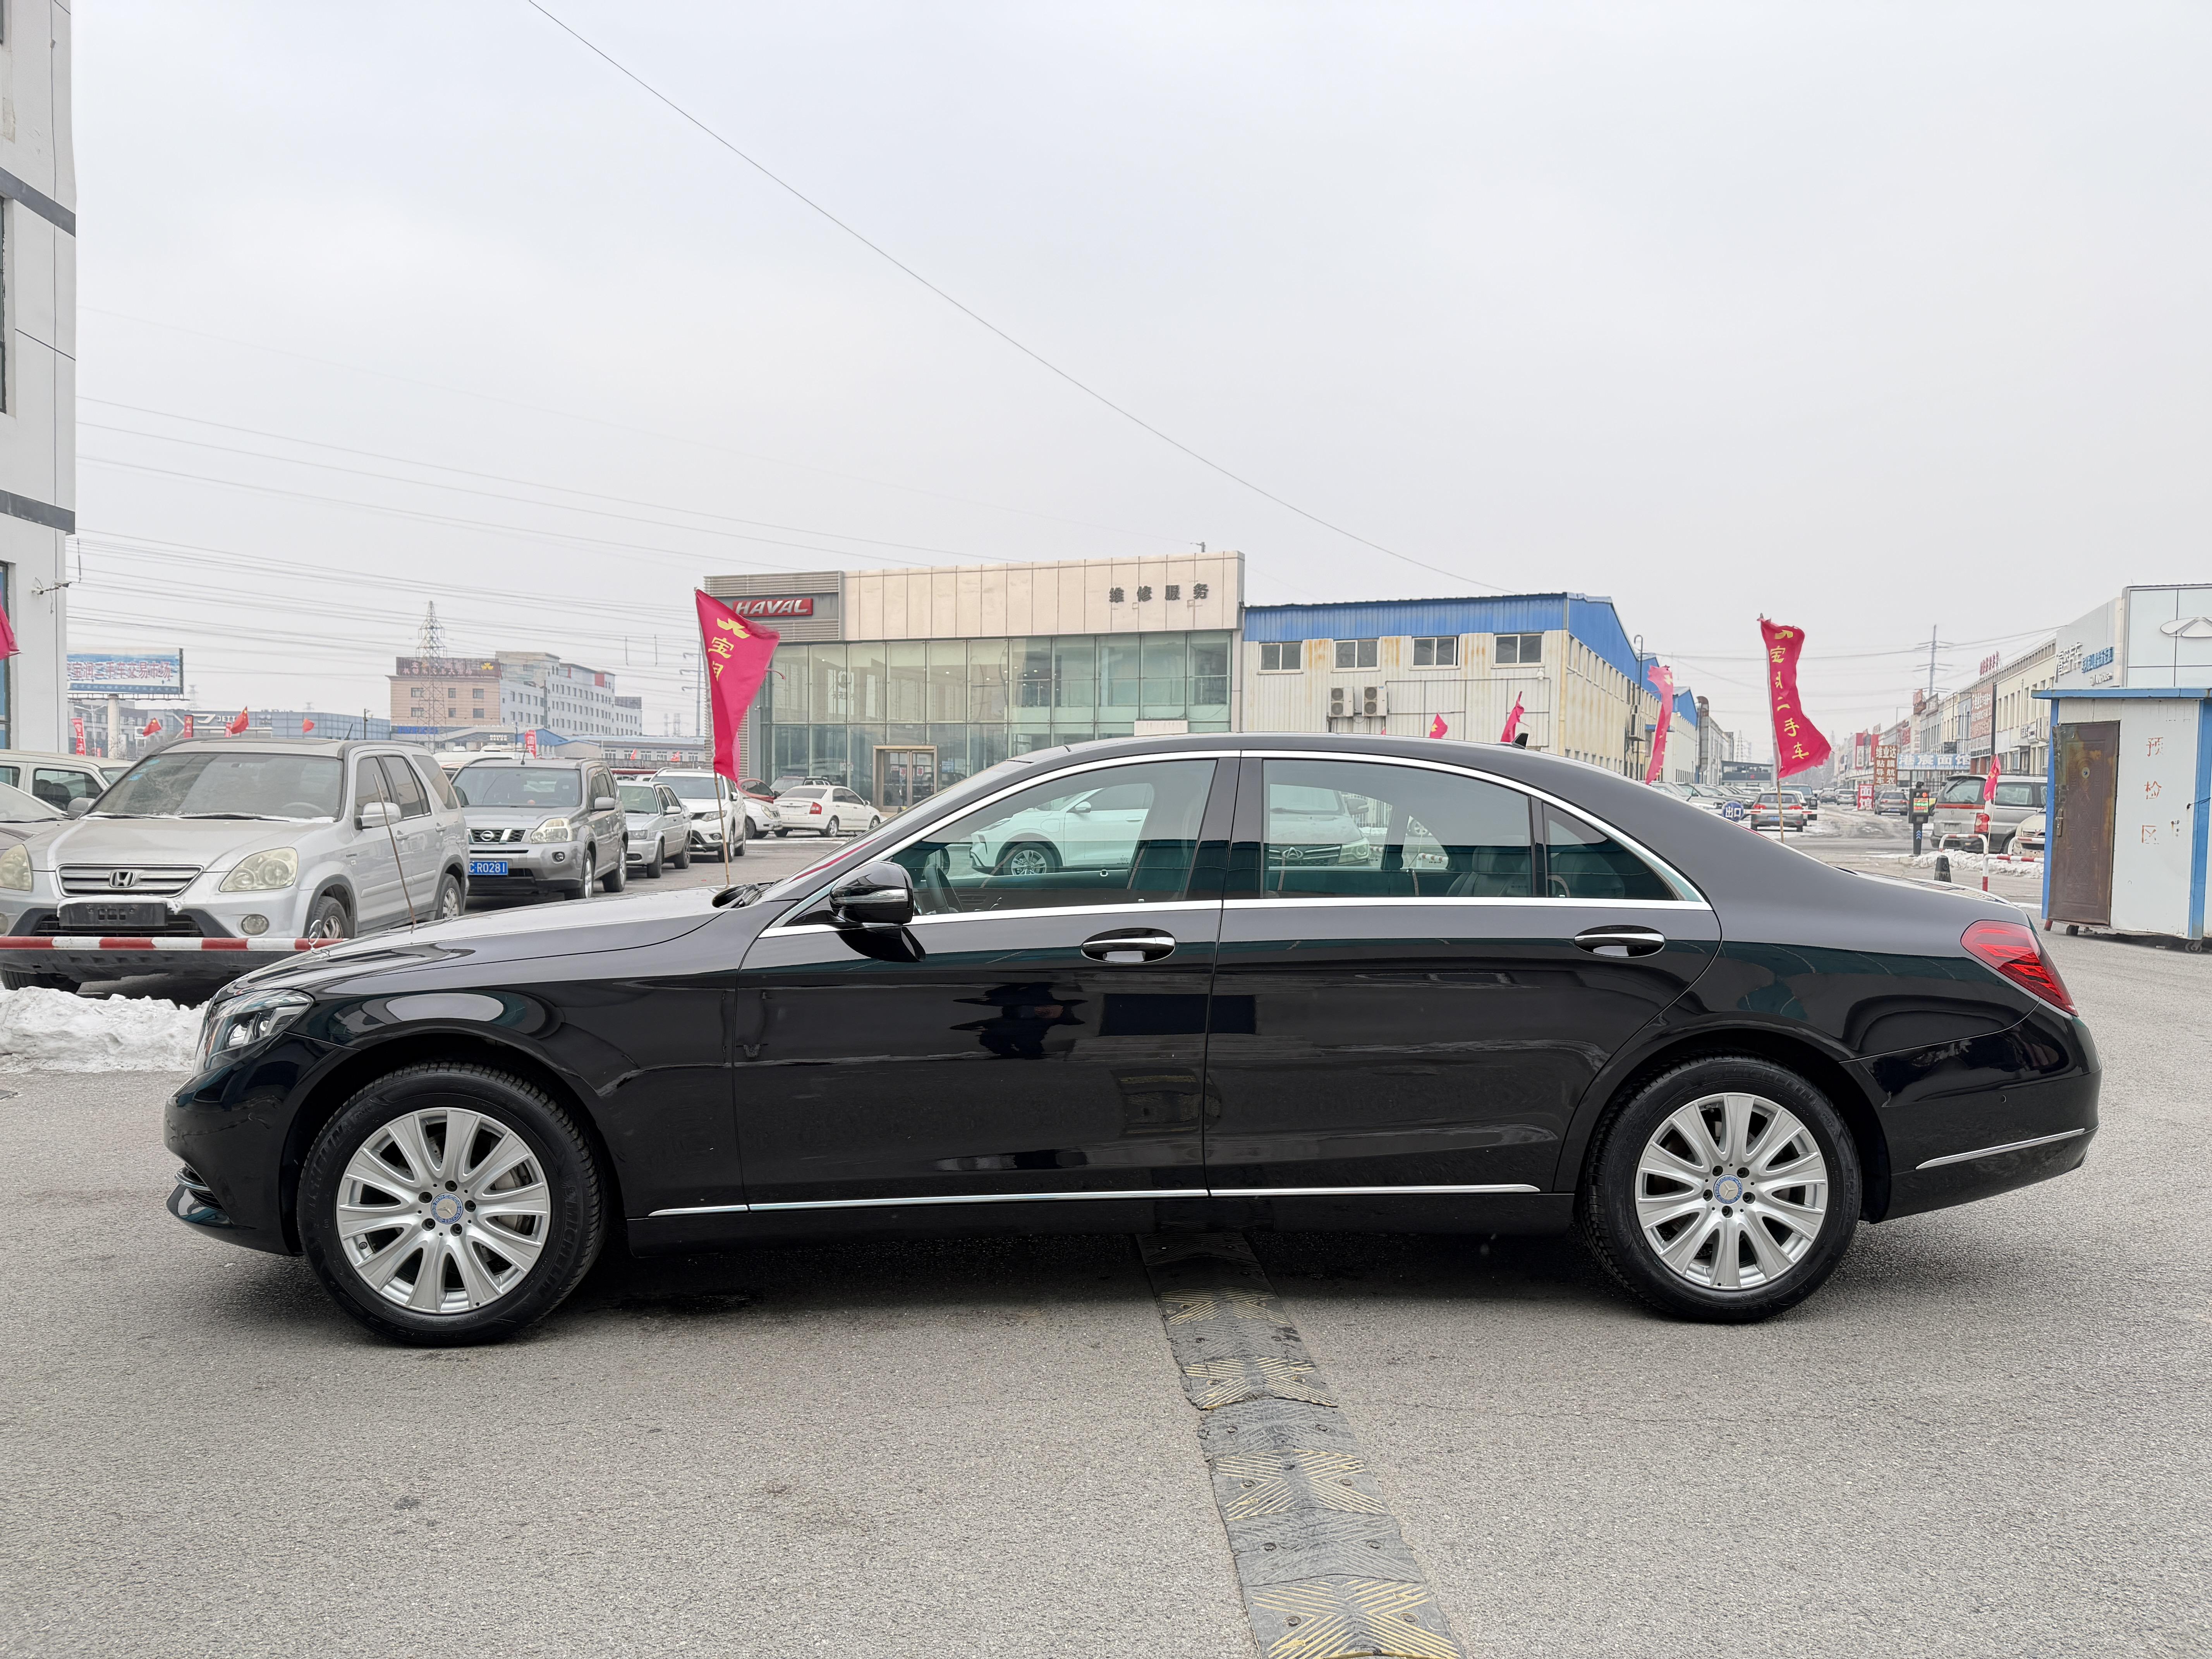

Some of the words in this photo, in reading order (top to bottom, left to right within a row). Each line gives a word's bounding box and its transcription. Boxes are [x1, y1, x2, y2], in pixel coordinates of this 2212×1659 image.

[1109, 583, 1209, 603] 维修服务
[735, 599, 809, 615] HAVAL
[2142, 737, 2164, 845] 预检区
[1726, 806, 1741, 818] 出口
[469, 863, 505, 873] C·R0281
